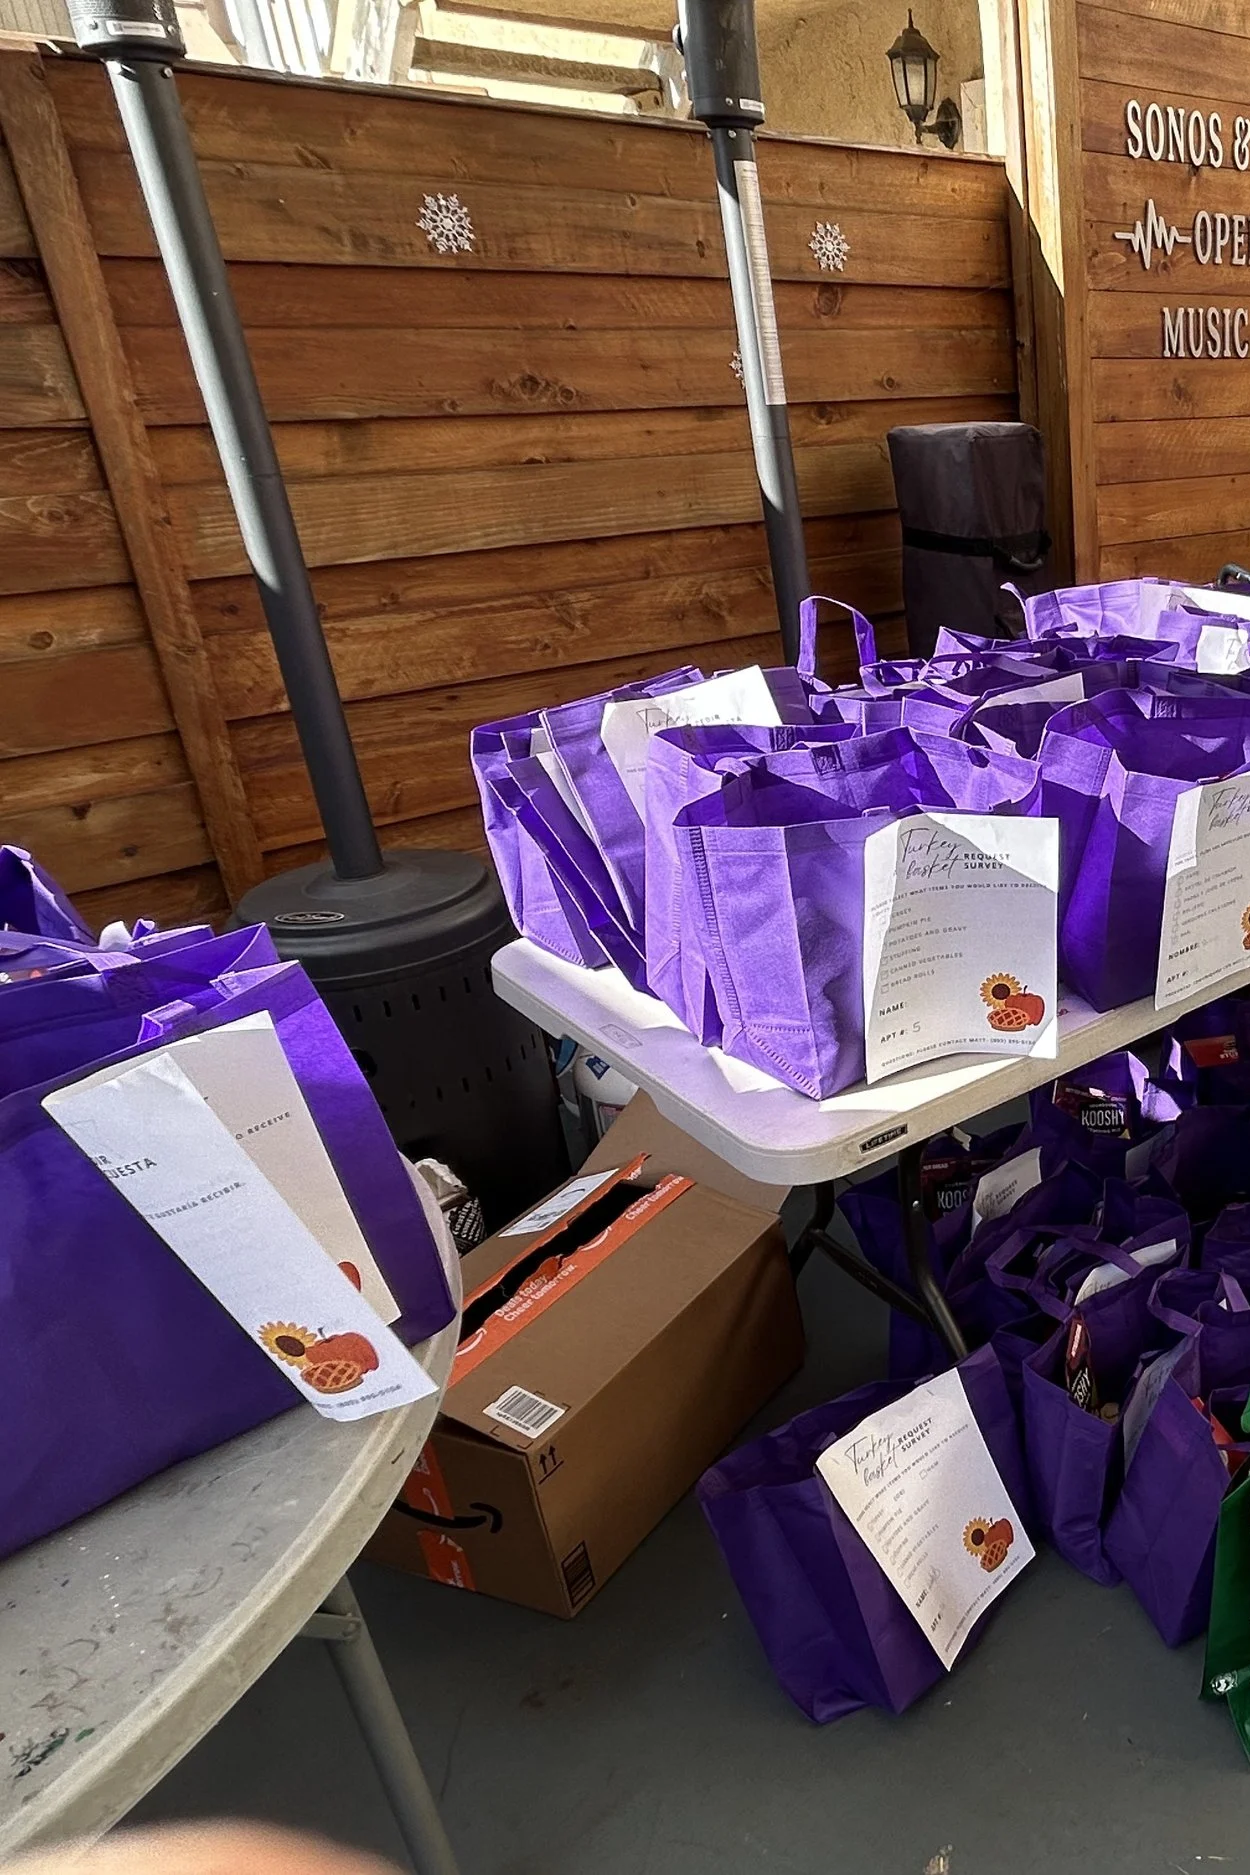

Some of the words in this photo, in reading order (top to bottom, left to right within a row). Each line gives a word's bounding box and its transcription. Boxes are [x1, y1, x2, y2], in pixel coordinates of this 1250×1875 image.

[1126, 99, 1223, 168] SONOS
[1233, 115, 1250, 171] &
[1162, 306, 1250, 359] MUSIC
[900, 827, 963, 863] Turkey
[906, 854, 964, 879] basket
[964, 862, 1004, 870] SURVEY
[880, 1031, 897, 1044] APT
[247, 1111, 290, 1135] RECEIVE
[1081, 1109, 1125, 1127] KOOSHY
[503, 1298, 535, 1322] Cheer
[530, 1264, 578, 1300] tomorrow.
[495, 1295, 523, 1318] Deals
[897, 1417, 933, 1443] REQUEST
[901, 1427, 931, 1453] SURVEY
[844, 1432, 894, 1475] Turkey
